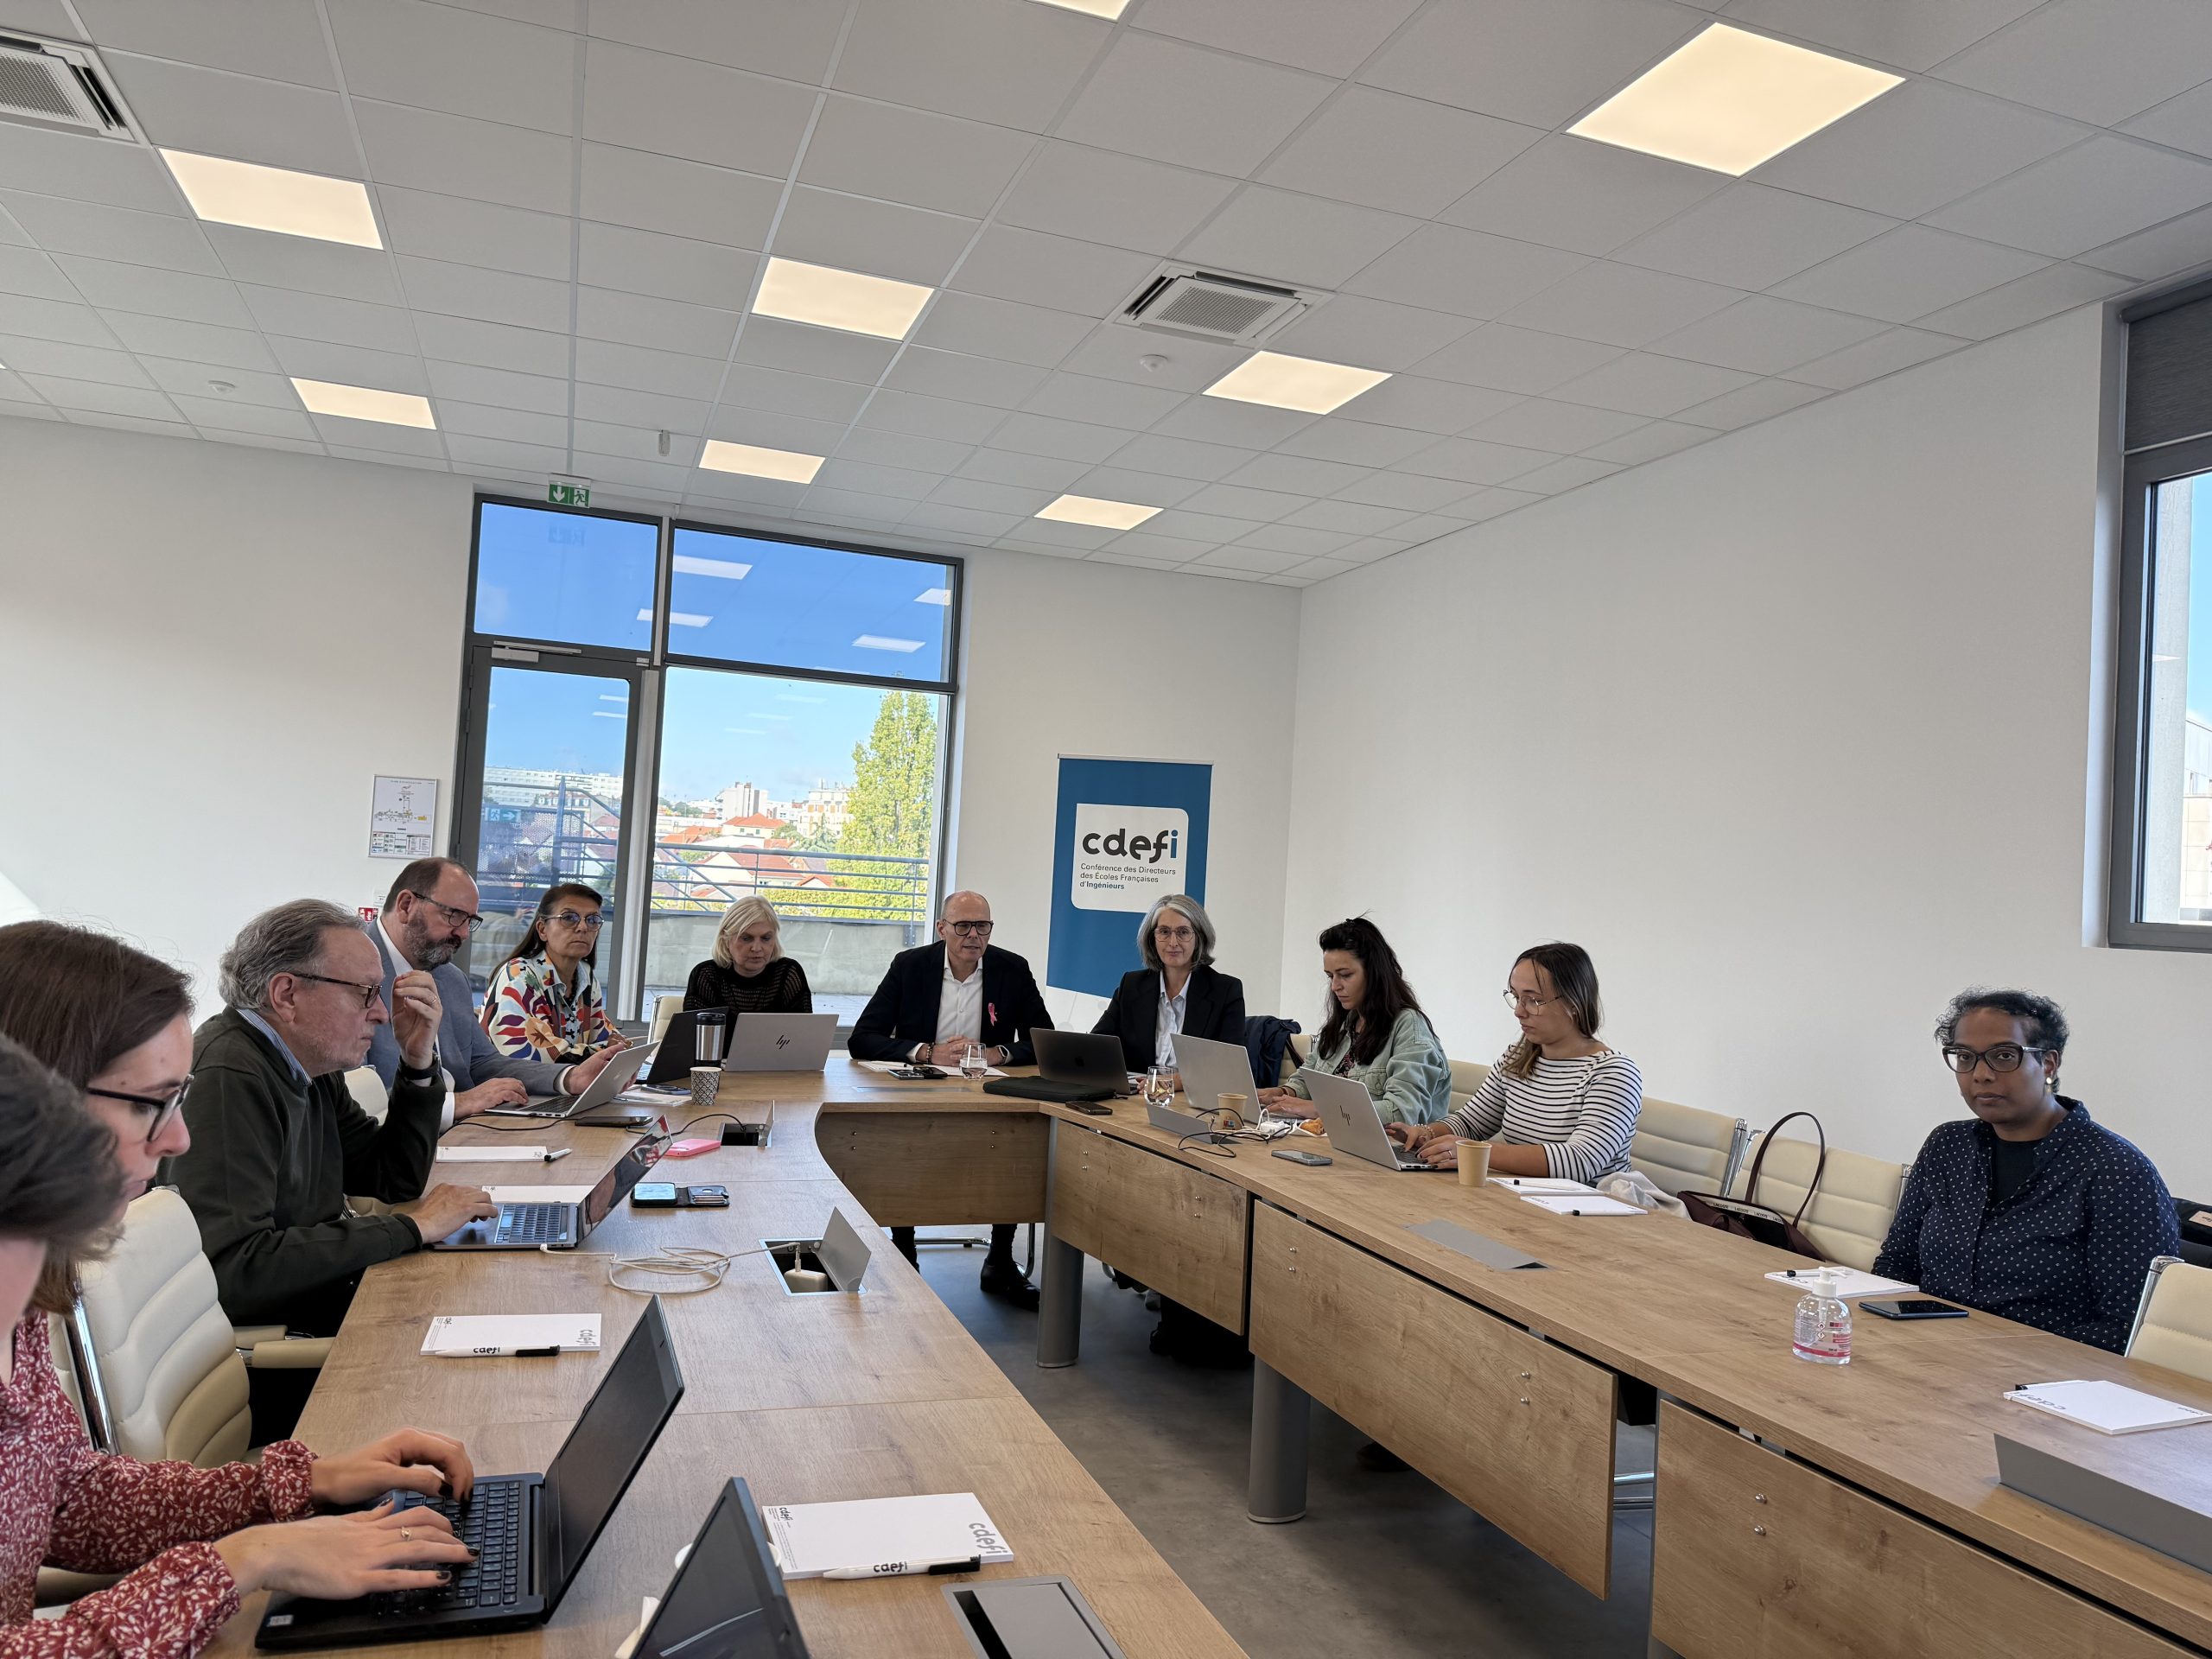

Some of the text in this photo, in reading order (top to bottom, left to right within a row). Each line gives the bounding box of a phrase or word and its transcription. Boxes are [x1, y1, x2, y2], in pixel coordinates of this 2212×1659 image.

[1082, 828, 1179, 864] cdefi
[1080, 862, 1122, 872] Conférence
[1139, 866, 1176, 875] Directeurs
[1095, 871, 1119, 880] Écoles
[1120, 874, 1159, 883] Françaises
[776, 1034, 791, 1050] hp
[1339, 1105, 1351, 1127] hp
[968, 1522, 1008, 1554] cdefi
